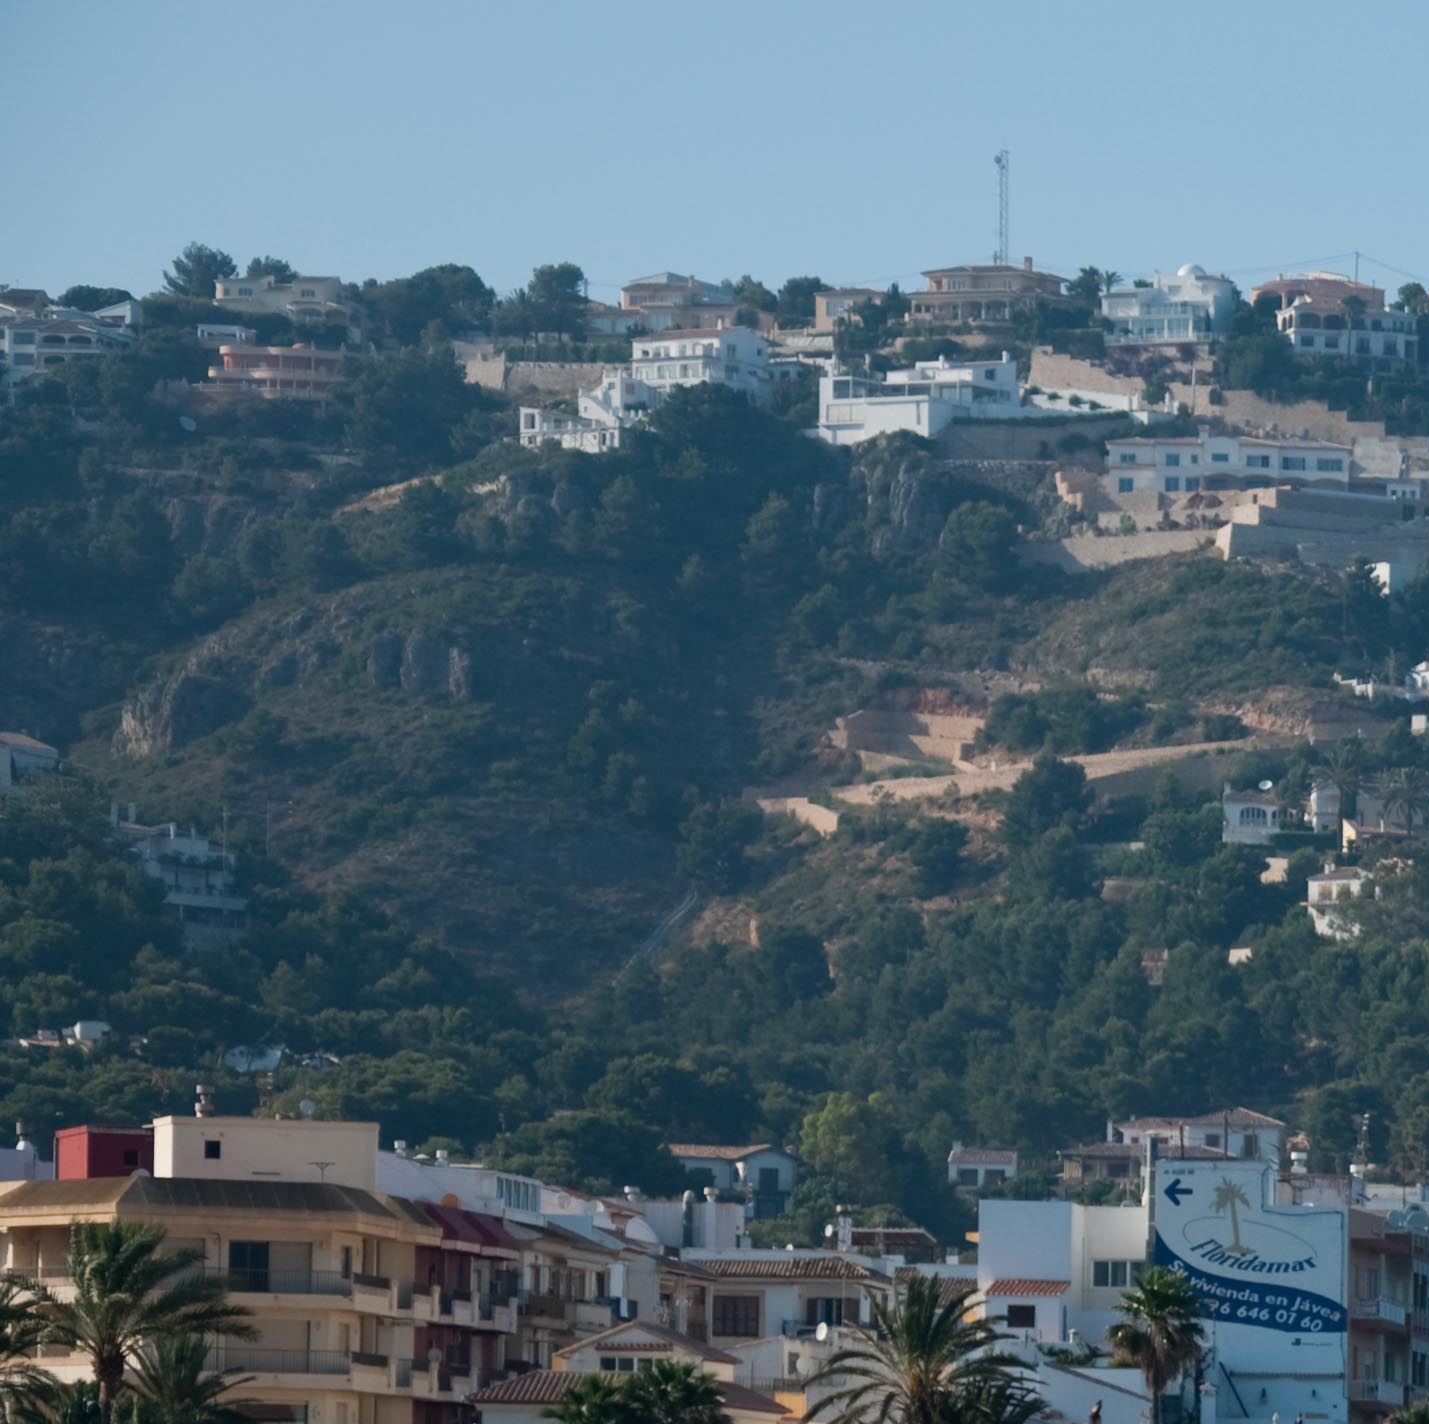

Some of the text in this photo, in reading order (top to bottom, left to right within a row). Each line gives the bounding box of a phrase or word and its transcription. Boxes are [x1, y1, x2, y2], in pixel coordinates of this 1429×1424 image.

[1190, 1238, 1317, 1273] Floridamar
[1190, 1276, 1259, 1303] vivienda
[1265, 1295, 1288, 1306] en
[1291, 1296, 1341, 1322] Jávea
[1236, 1305, 1270, 1320] 646
[1275, 1309, 1297, 1324] 07
[1300, 1316, 1323, 1332] 60
